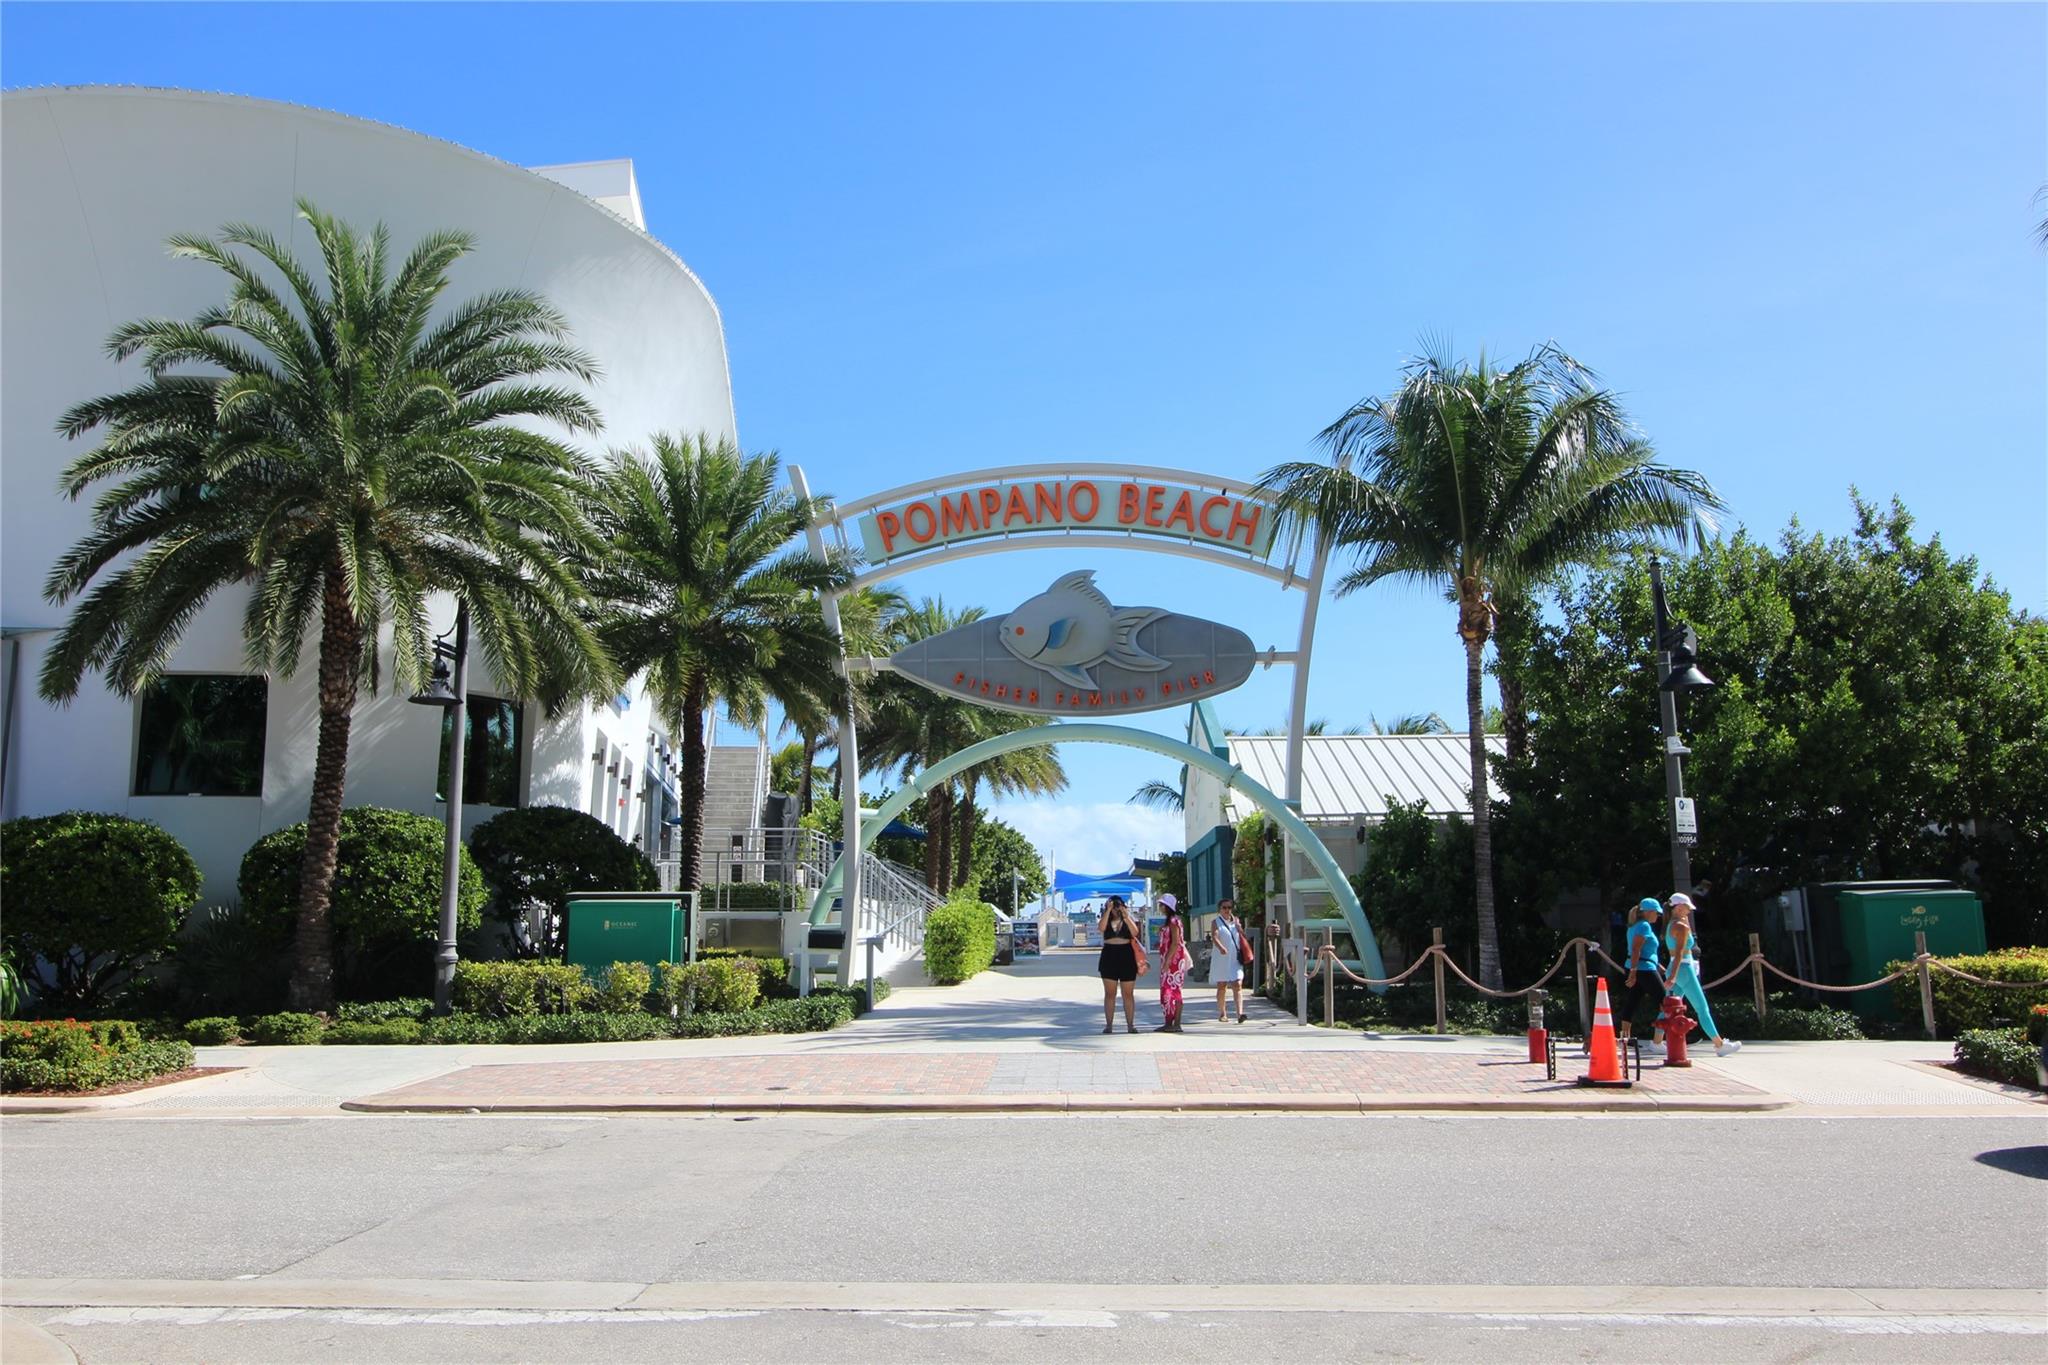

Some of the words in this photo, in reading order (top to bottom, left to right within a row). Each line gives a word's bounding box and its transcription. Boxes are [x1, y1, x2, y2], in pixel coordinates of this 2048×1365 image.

[876, 481, 1099, 552] POMPANO
[1118, 484, 1262, 546] BEACH
[953, 672, 1039, 704] FISHER
[1055, 688, 1146, 706] FAMILY
[1161, 670, 1216, 696] PIER
